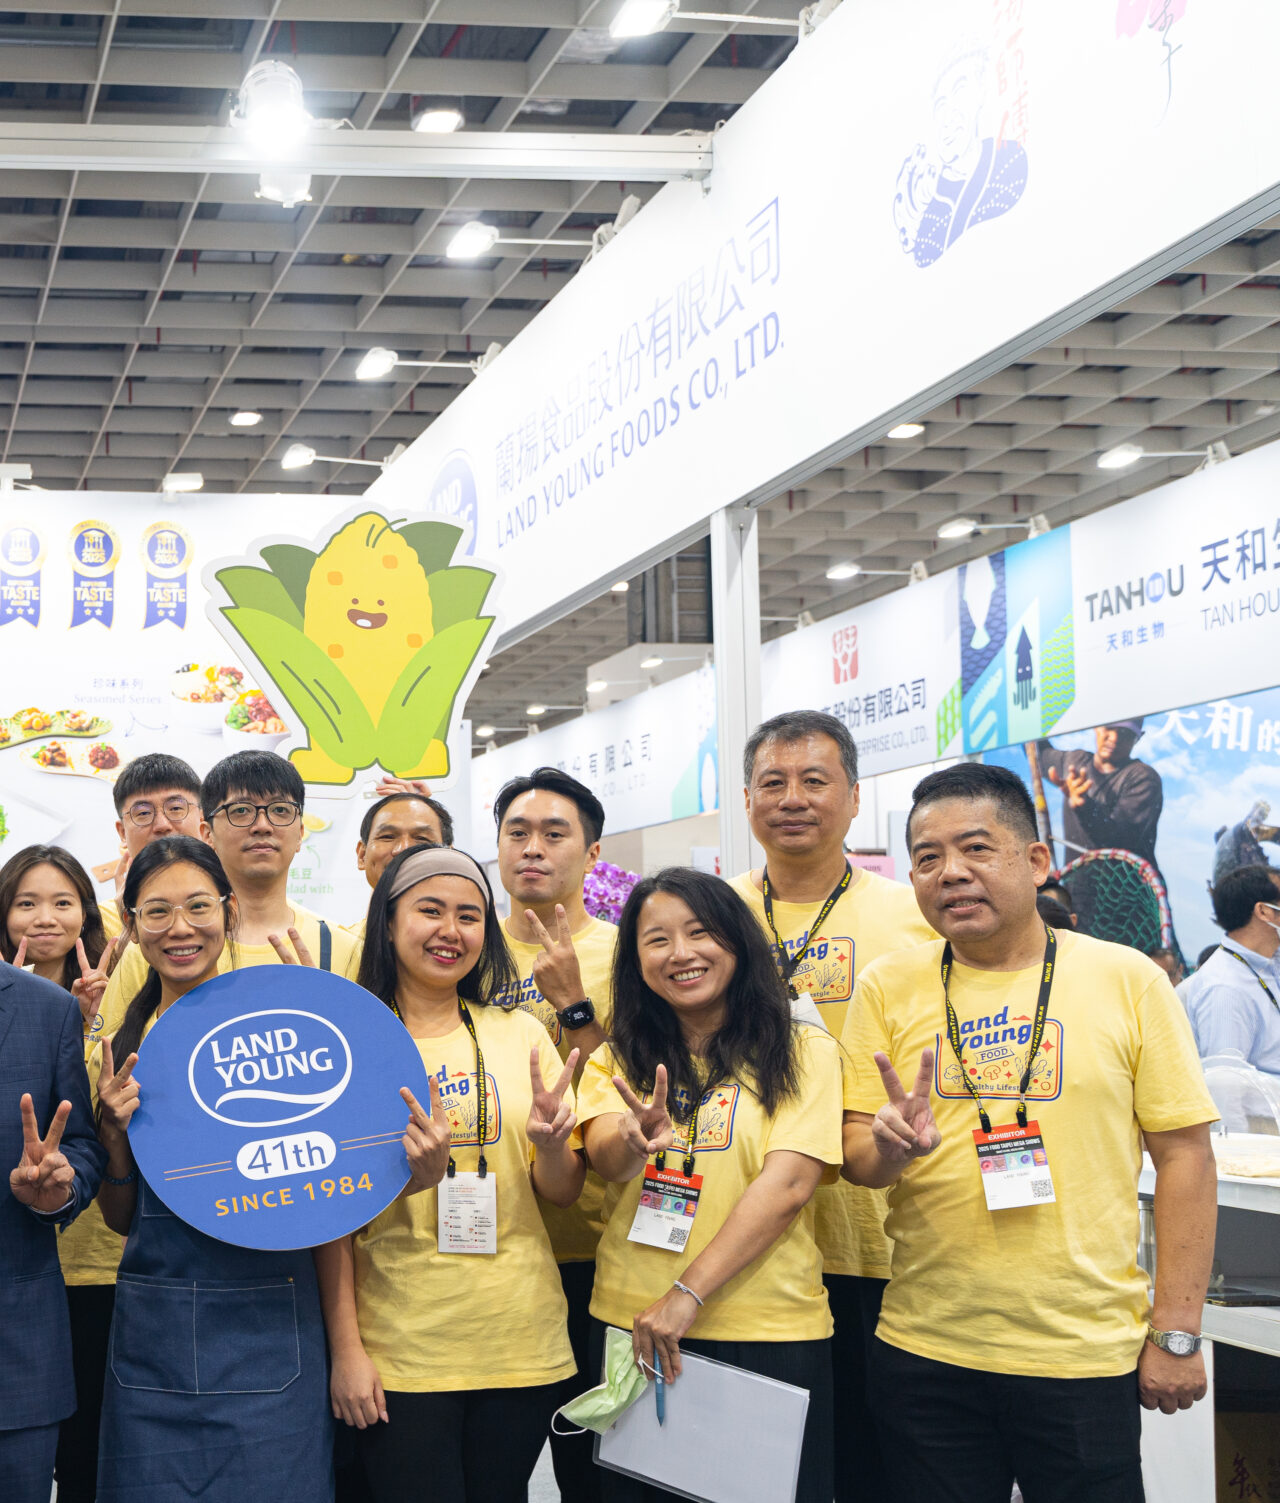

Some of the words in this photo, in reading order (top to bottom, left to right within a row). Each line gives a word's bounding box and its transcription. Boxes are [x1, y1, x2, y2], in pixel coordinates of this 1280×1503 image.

[495, 195, 781, 500] 蘭揚食品股份有限公司
[497, 494, 538, 549] LAND
[542, 441, 604, 515] YOUNG
[610, 384, 681, 469] FOODS
[687, 356, 729, 400] CO.,
[733, 310, 785, 380] LTD.
[1, 586, 40, 601] TASTE
[74, 587, 113, 602] TASTE
[147, 588, 186, 603] TASTE
[1200, 601, 1234, 631] TAN
[1106, 620, 1165, 653] 天和生物
[73, 693, 126, 705] Seasoned
[128, 693, 163, 705] Series
[211, 1028, 299, 1064] LAND
[980, 1047, 1009, 1061] FOOD
[214, 1047, 334, 1089] YOUNG
[988, 1129, 1026, 1141] EXHIBITOR
[247, 1140, 327, 1175] 41th
[657, 1173, 690, 1185] EXHIBITOR
[215, 1188, 294, 1217] SINCE
[303, 1173, 374, 1201] 1984
